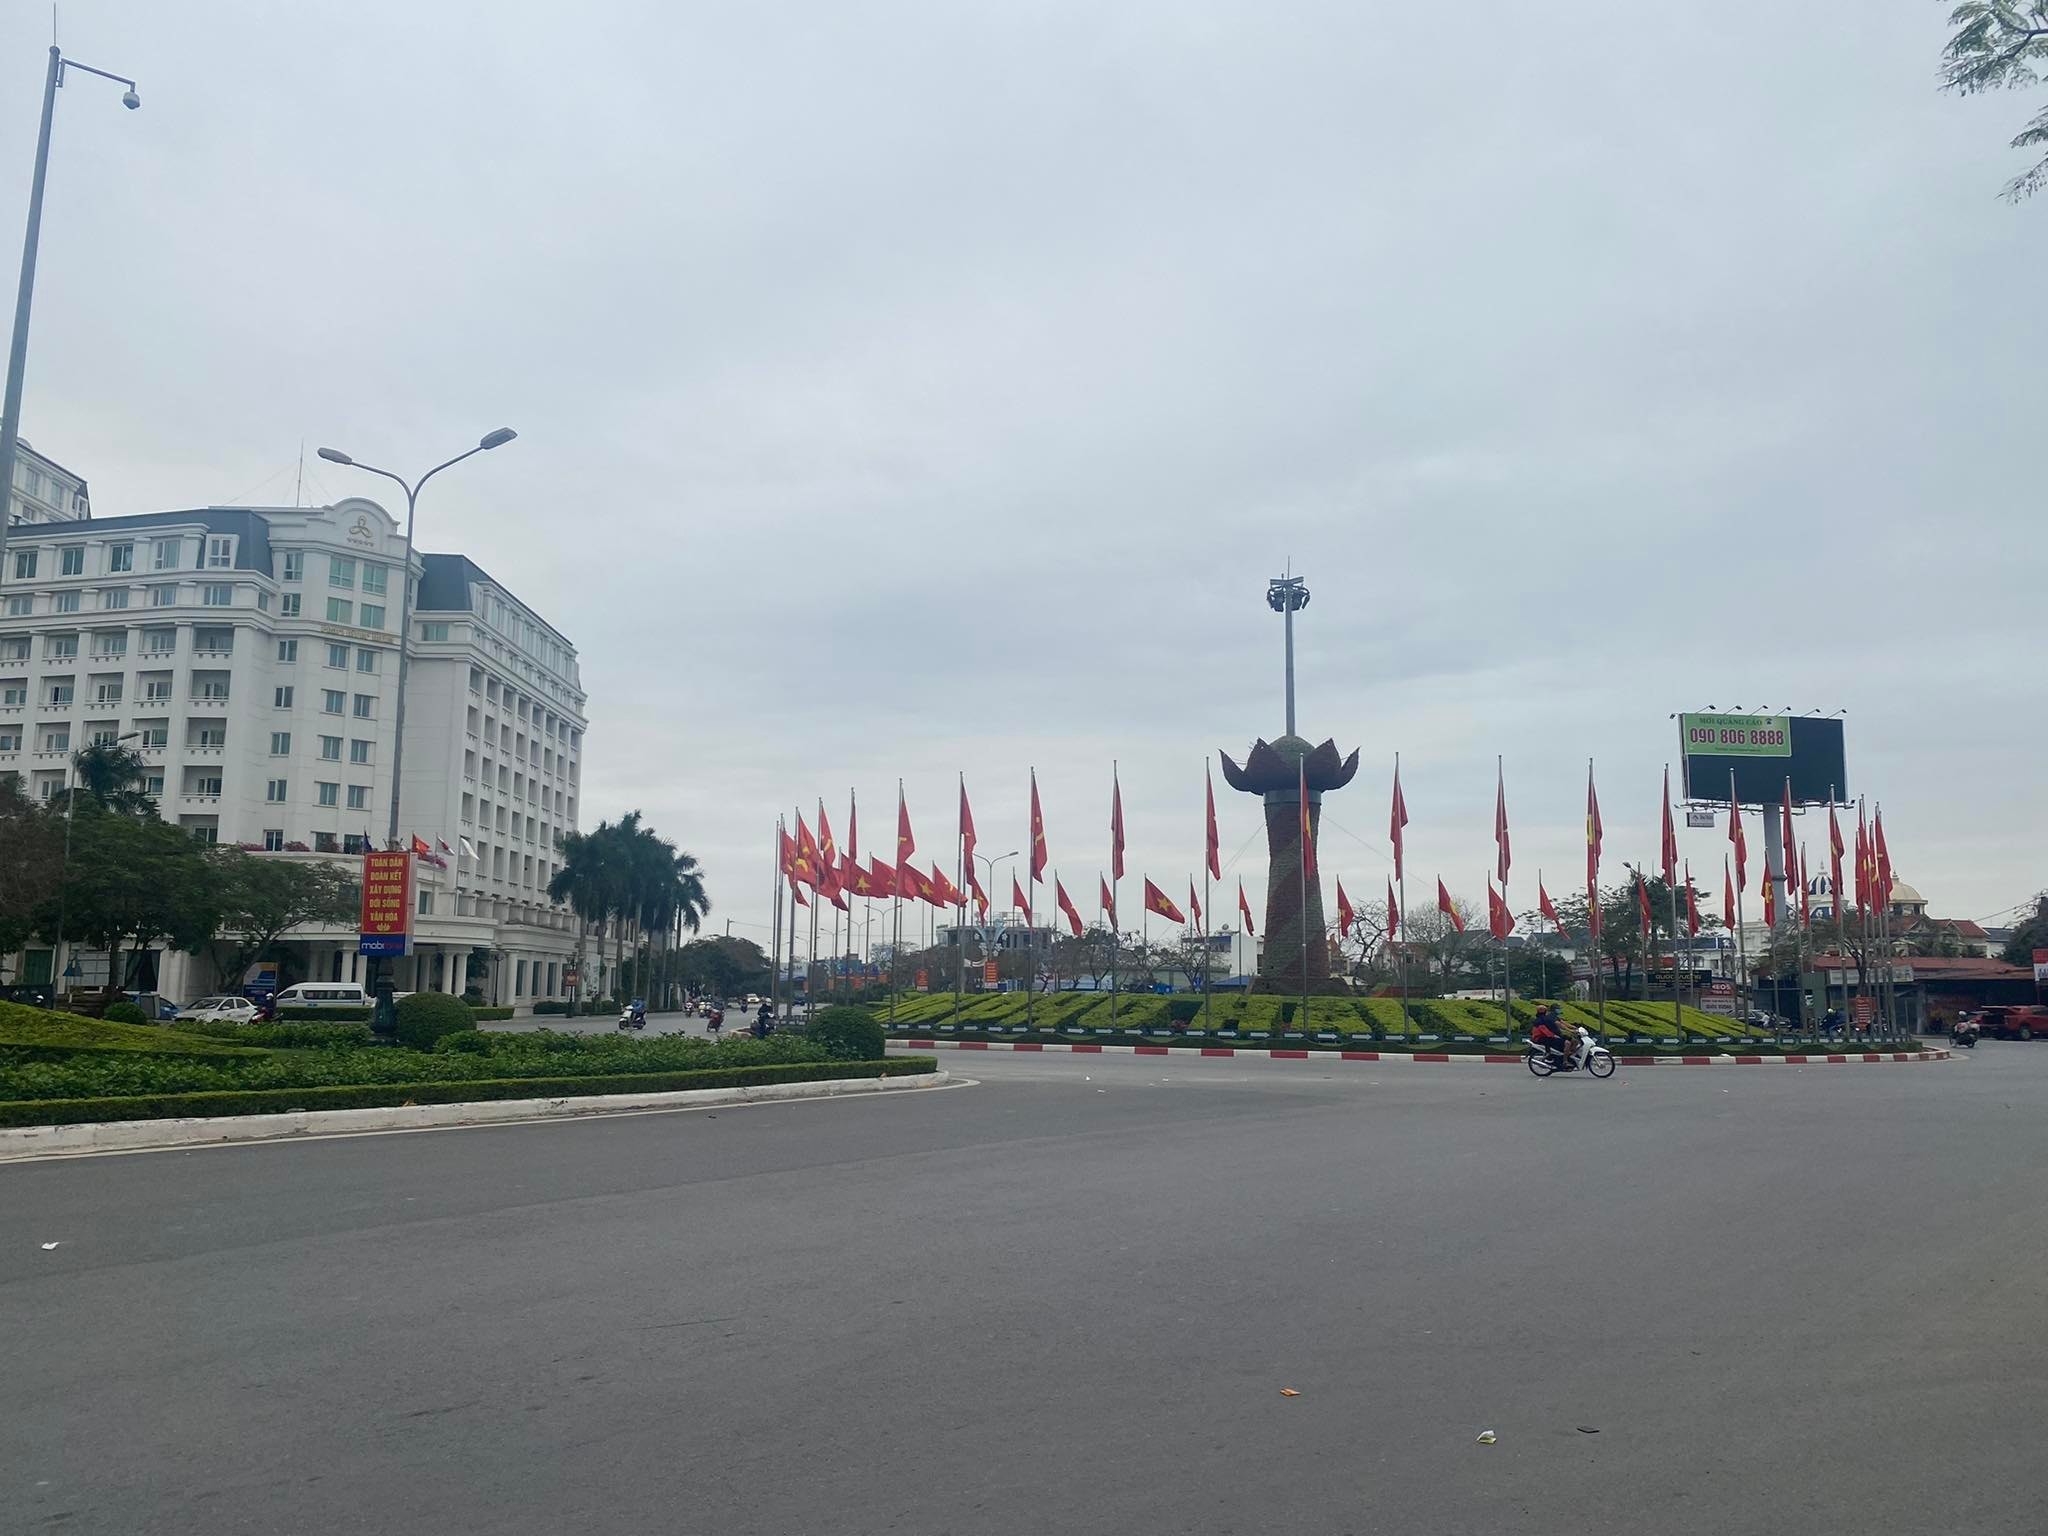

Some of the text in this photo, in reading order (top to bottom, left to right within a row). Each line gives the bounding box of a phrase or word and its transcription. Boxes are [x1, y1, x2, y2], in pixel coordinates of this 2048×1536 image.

[1690, 728, 1784, 745] 090 806 8888
[389, 869, 402, 880] KẾT
[369, 884, 382, 894] XÂY
[382, 897, 400, 908] SỐNG
